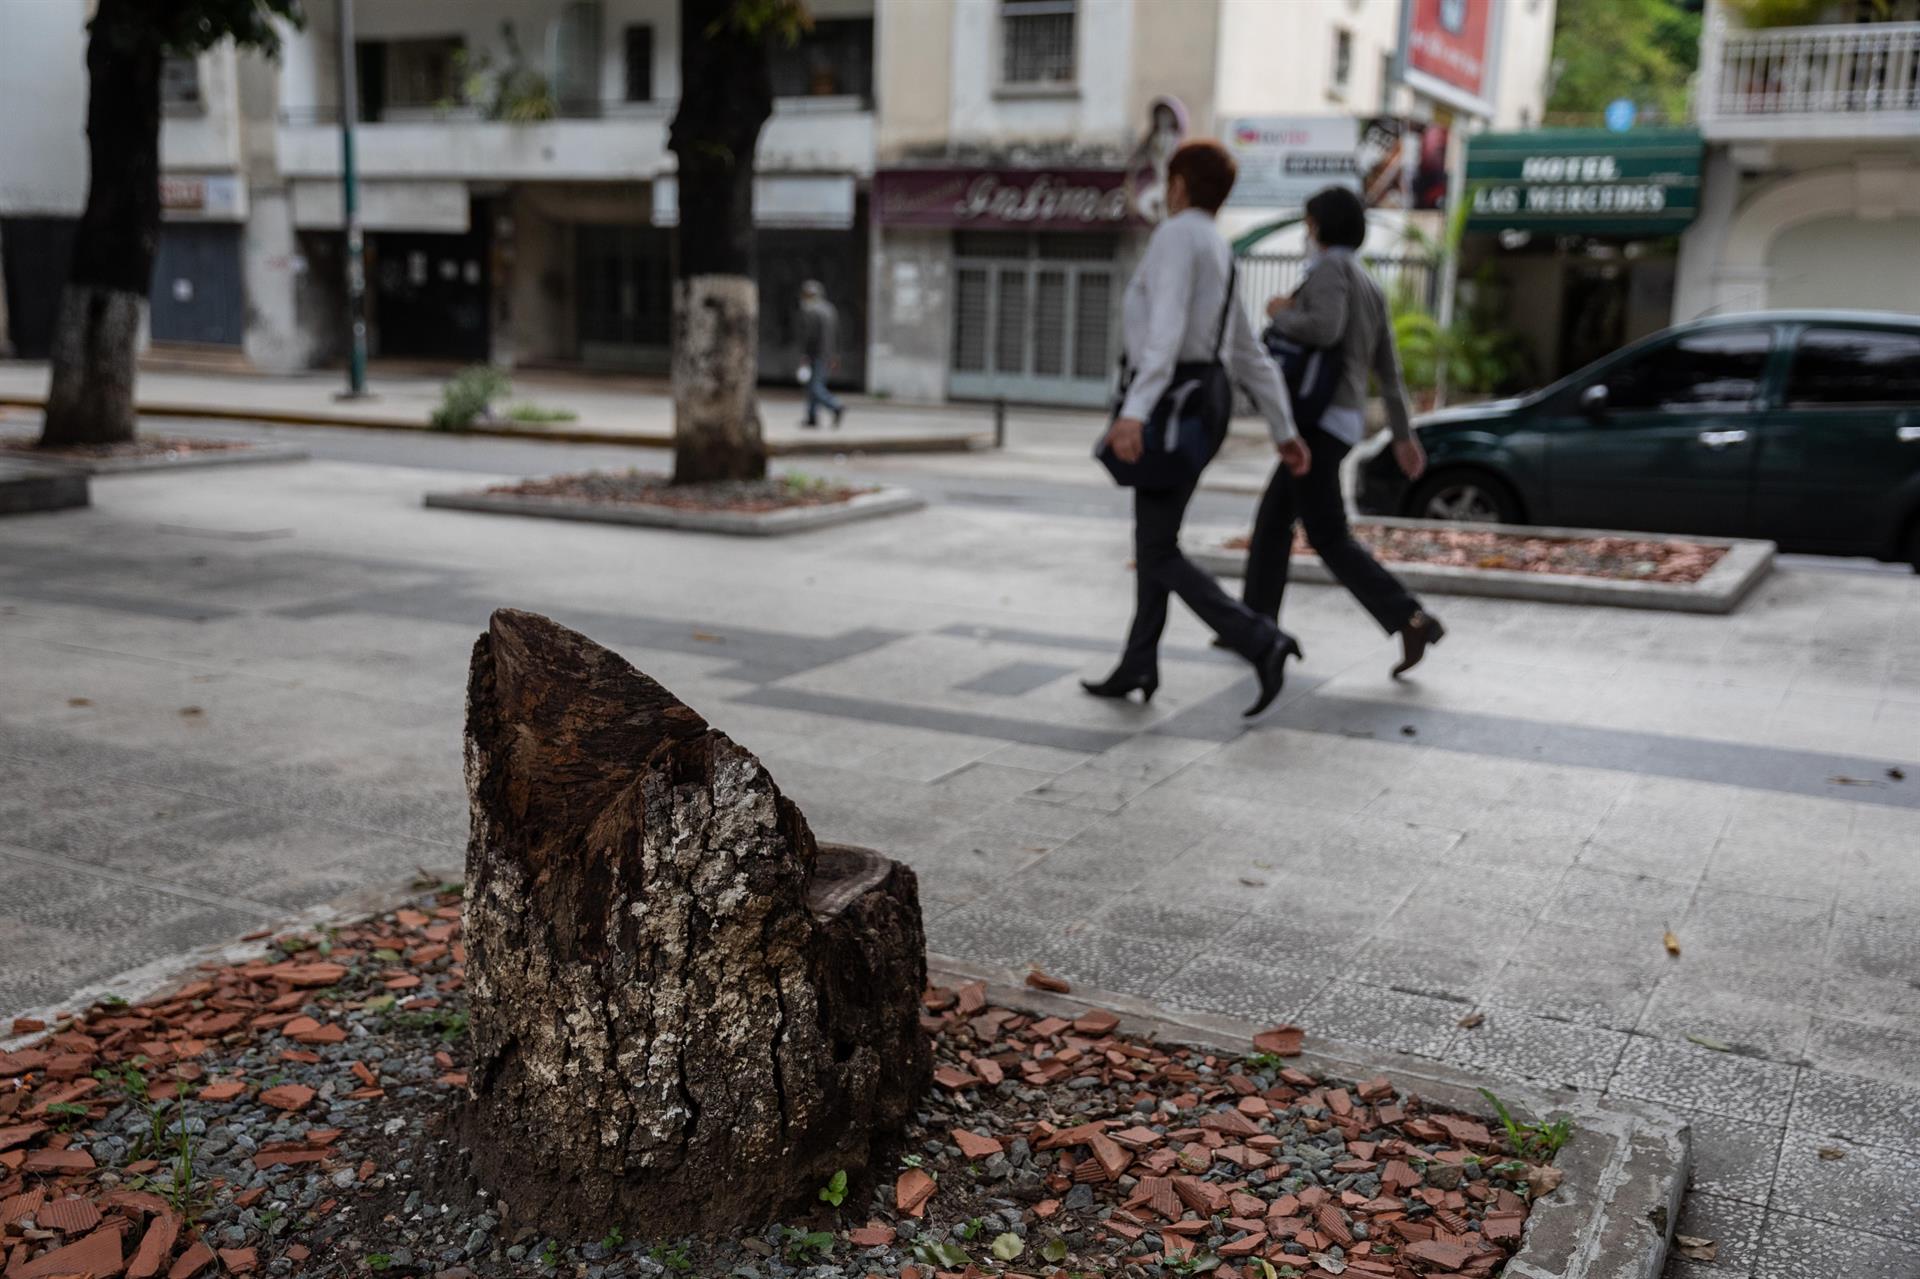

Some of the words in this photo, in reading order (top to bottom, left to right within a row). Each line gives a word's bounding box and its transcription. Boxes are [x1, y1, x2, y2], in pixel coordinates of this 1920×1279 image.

[1522, 156, 1620, 182] HOTEL
[1474, 186, 1519, 213] LAS
[1526, 185, 1666, 212] MERCEDES
